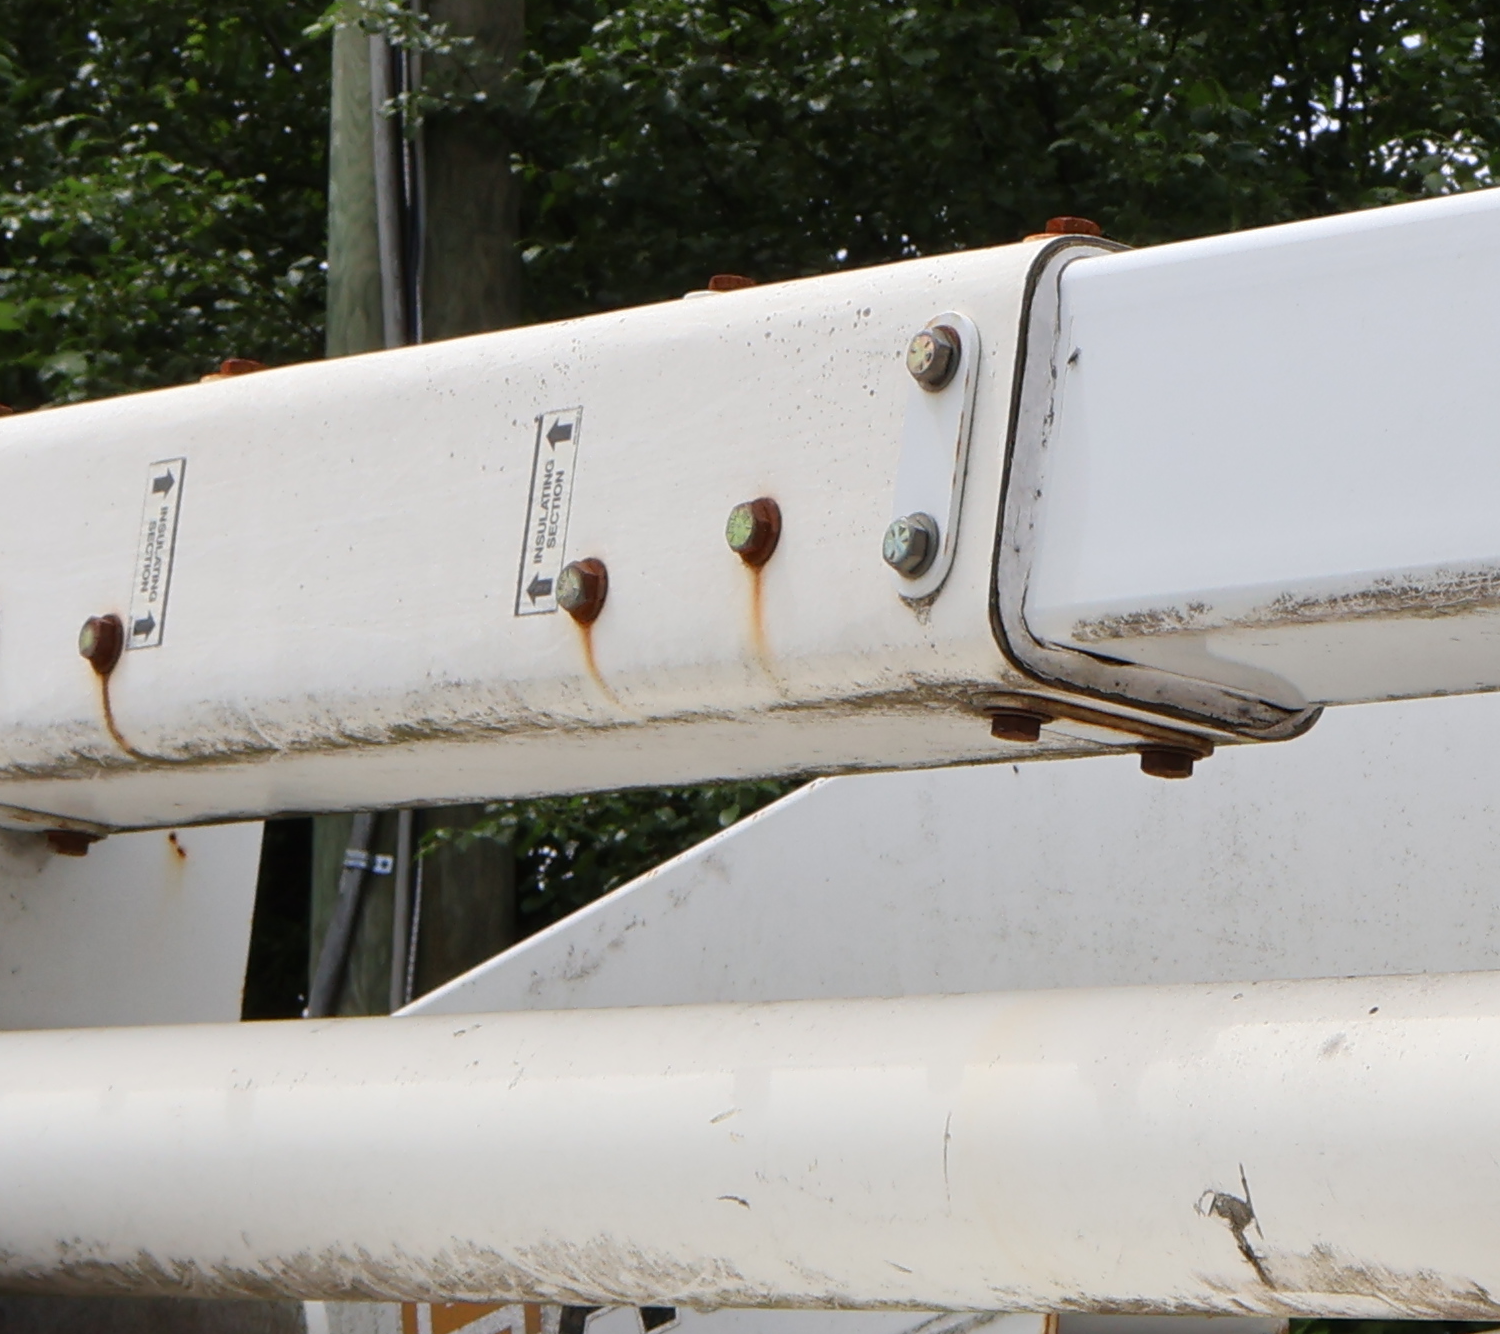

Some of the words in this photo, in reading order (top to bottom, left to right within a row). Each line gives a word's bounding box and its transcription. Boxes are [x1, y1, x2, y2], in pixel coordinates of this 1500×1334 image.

[533, 460, 555, 564] INSULATING
[546, 470, 565, 549] SECTION
[140, 521, 157, 593] SECTION
[149, 506, 169, 603] INSULATING
